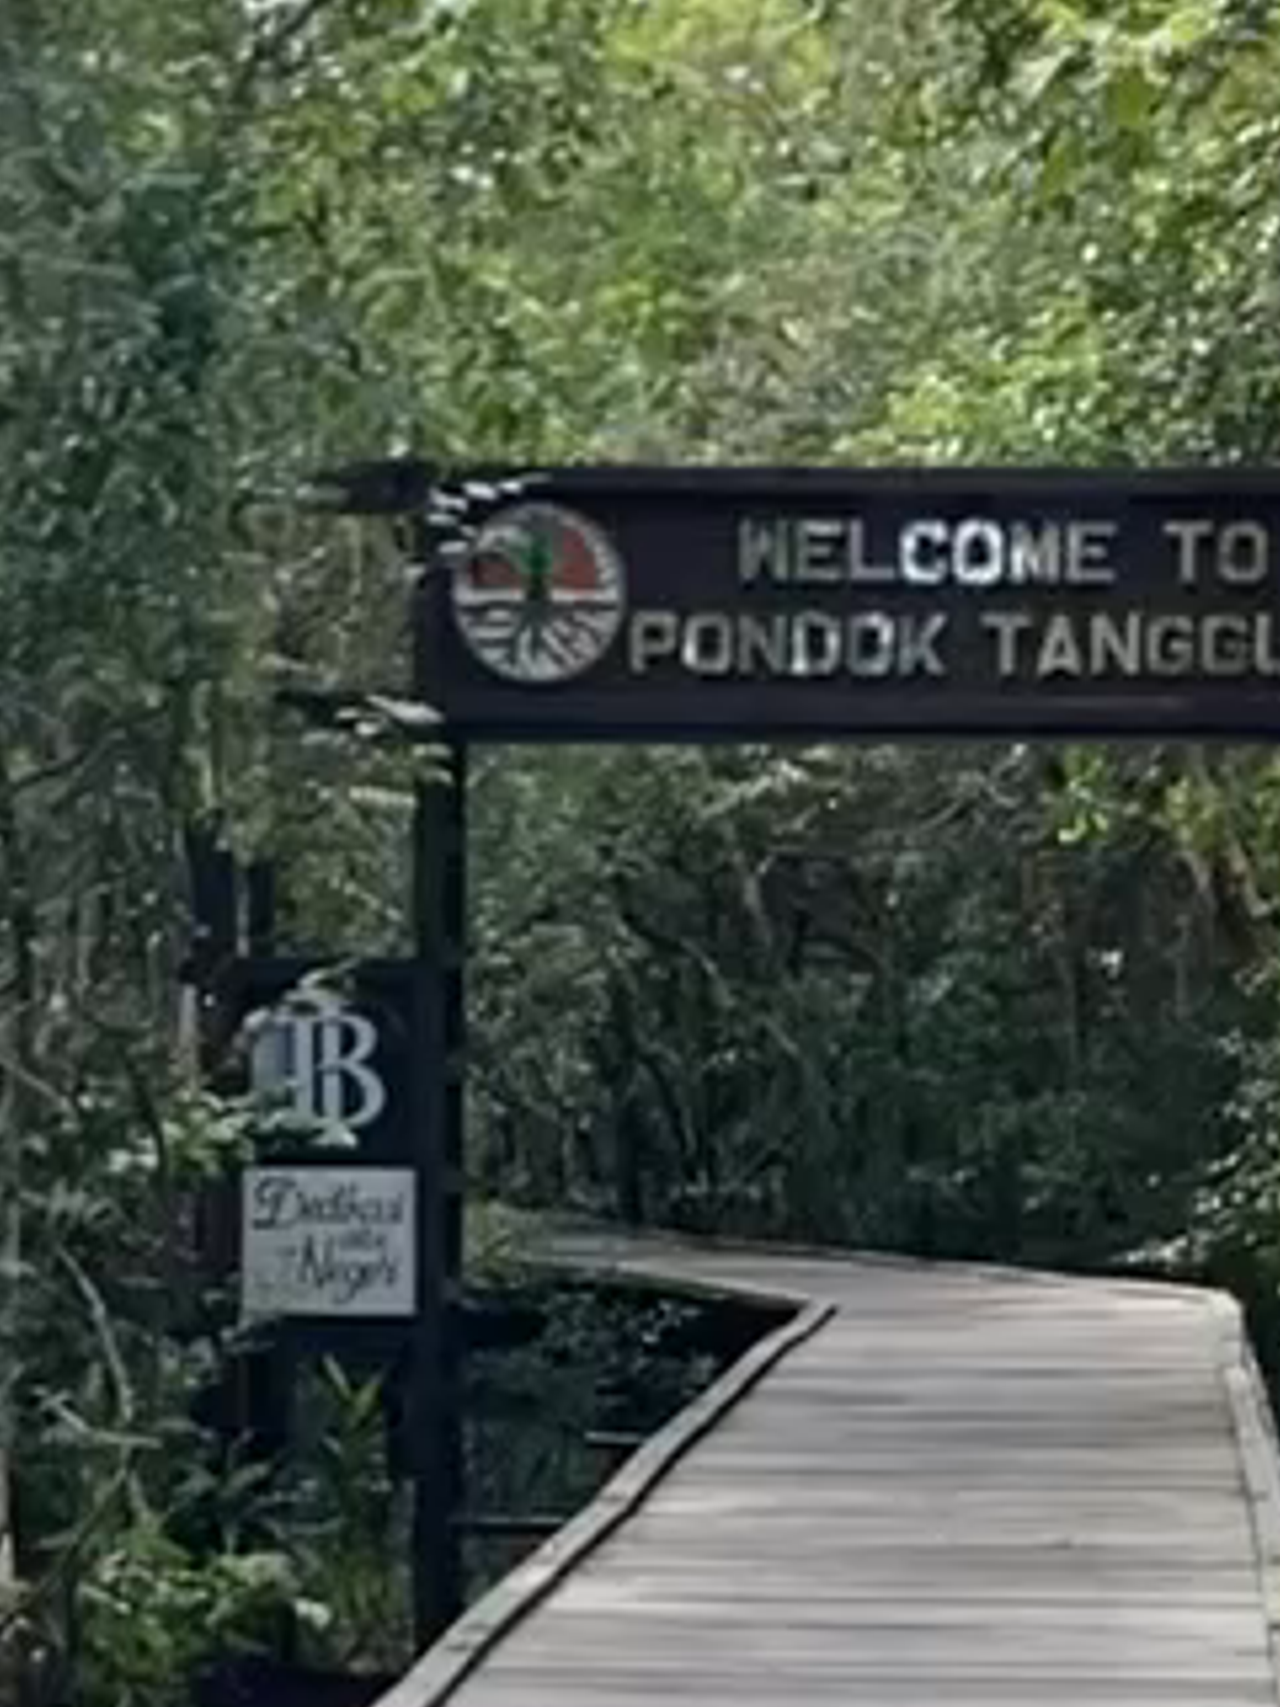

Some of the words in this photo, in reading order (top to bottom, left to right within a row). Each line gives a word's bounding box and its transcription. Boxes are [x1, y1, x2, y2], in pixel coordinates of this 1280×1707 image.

[736, 518, 1117, 584] WELCOME
[1162, 520, 1271, 583] TO
[627, 609, 947, 676] PONDOK
